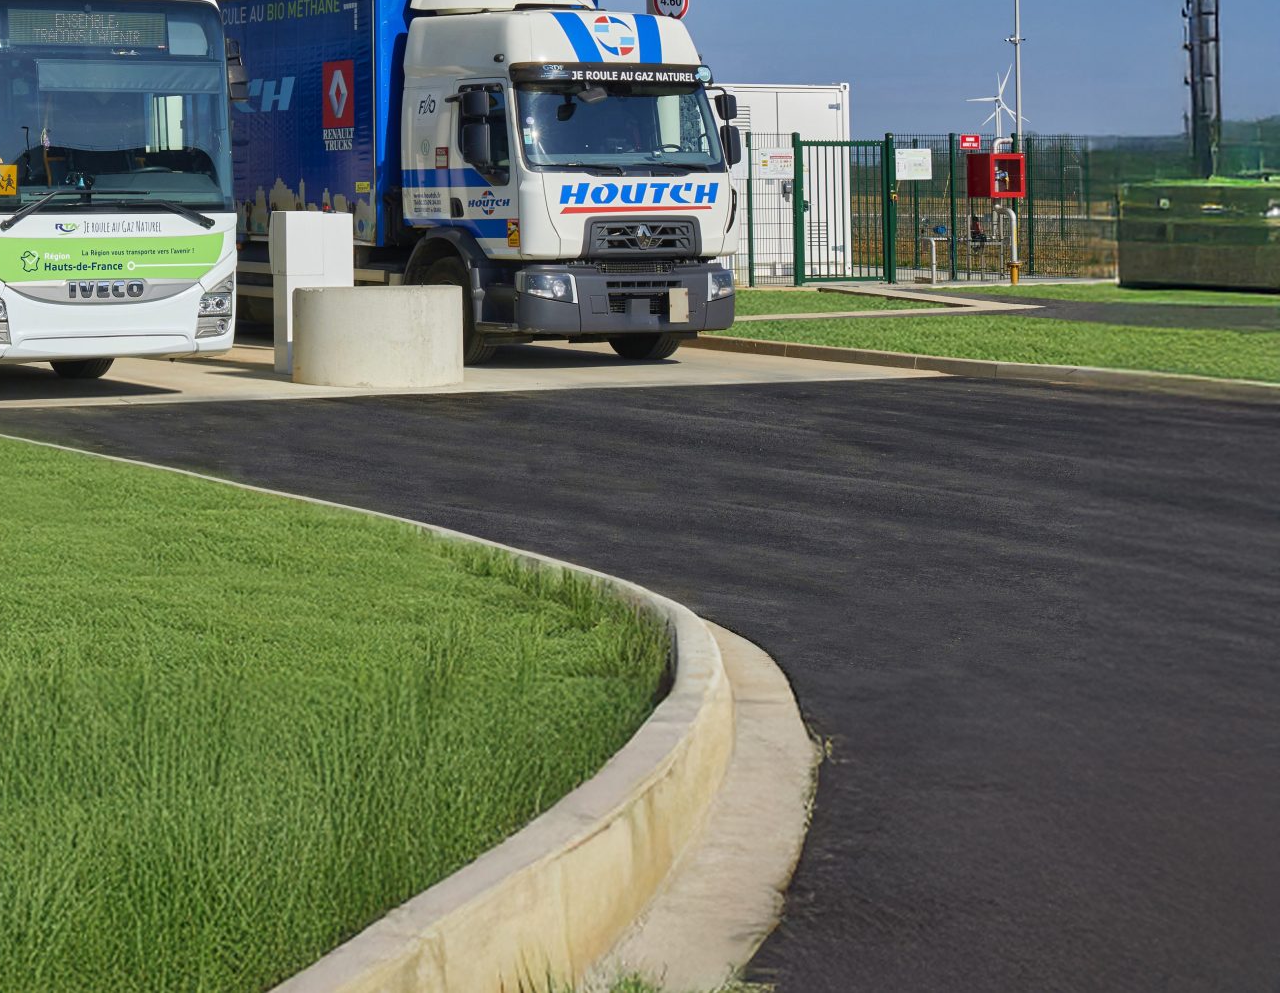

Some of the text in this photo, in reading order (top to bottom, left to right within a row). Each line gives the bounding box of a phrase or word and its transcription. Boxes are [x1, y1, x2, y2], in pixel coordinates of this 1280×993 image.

[250, 5, 264, 22] AU
[267, 2, 285, 21] BIO
[572, 71, 583, 80] JE
[586, 71, 618, 81] ROULE
[620, 71, 633, 81] AU
[635, 72, 653, 82] GAZ
[656, 72, 695, 83] NATUREL
[323, 127, 355, 140] RENAULT
[325, 139, 353, 151] TRUCKS
[559, 182, 719, 205] HOUTCH
[468, 198, 510, 208] HOUTCH
[83, 220, 90, 234] JE
[91, 222, 110, 233] ROULE
[111, 222, 121, 232] AU
[121, 220, 135, 233] GAZ
[135, 220, 162, 233] NATUREL
[44, 262, 123, 271] Hauts-de-France
[68, 280, 144, 298] IVECO
